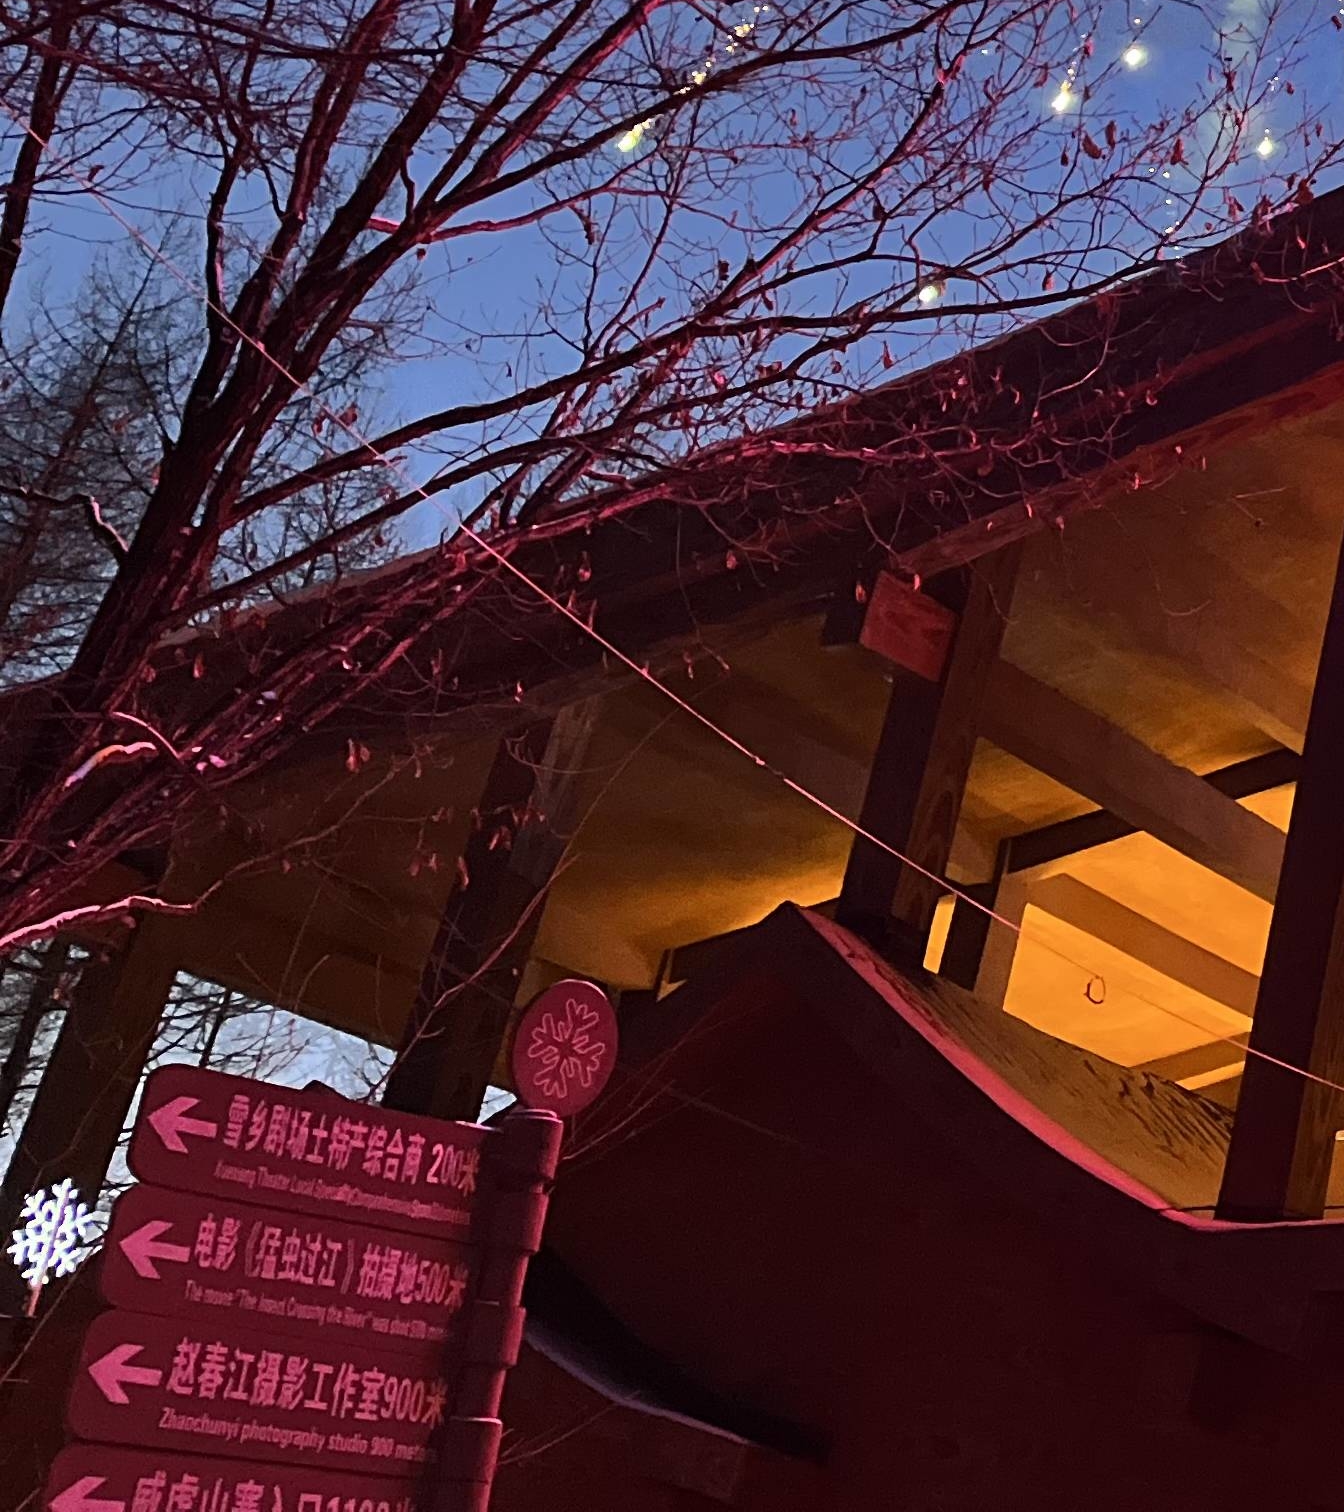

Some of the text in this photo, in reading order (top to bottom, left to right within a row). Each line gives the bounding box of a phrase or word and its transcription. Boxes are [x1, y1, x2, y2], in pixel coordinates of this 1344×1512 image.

[166, 1336, 447, 1429] 赵春江摄影工作室900米
[240, 1419, 325, 1454] photography
[328, 1432, 368, 1454] studio
